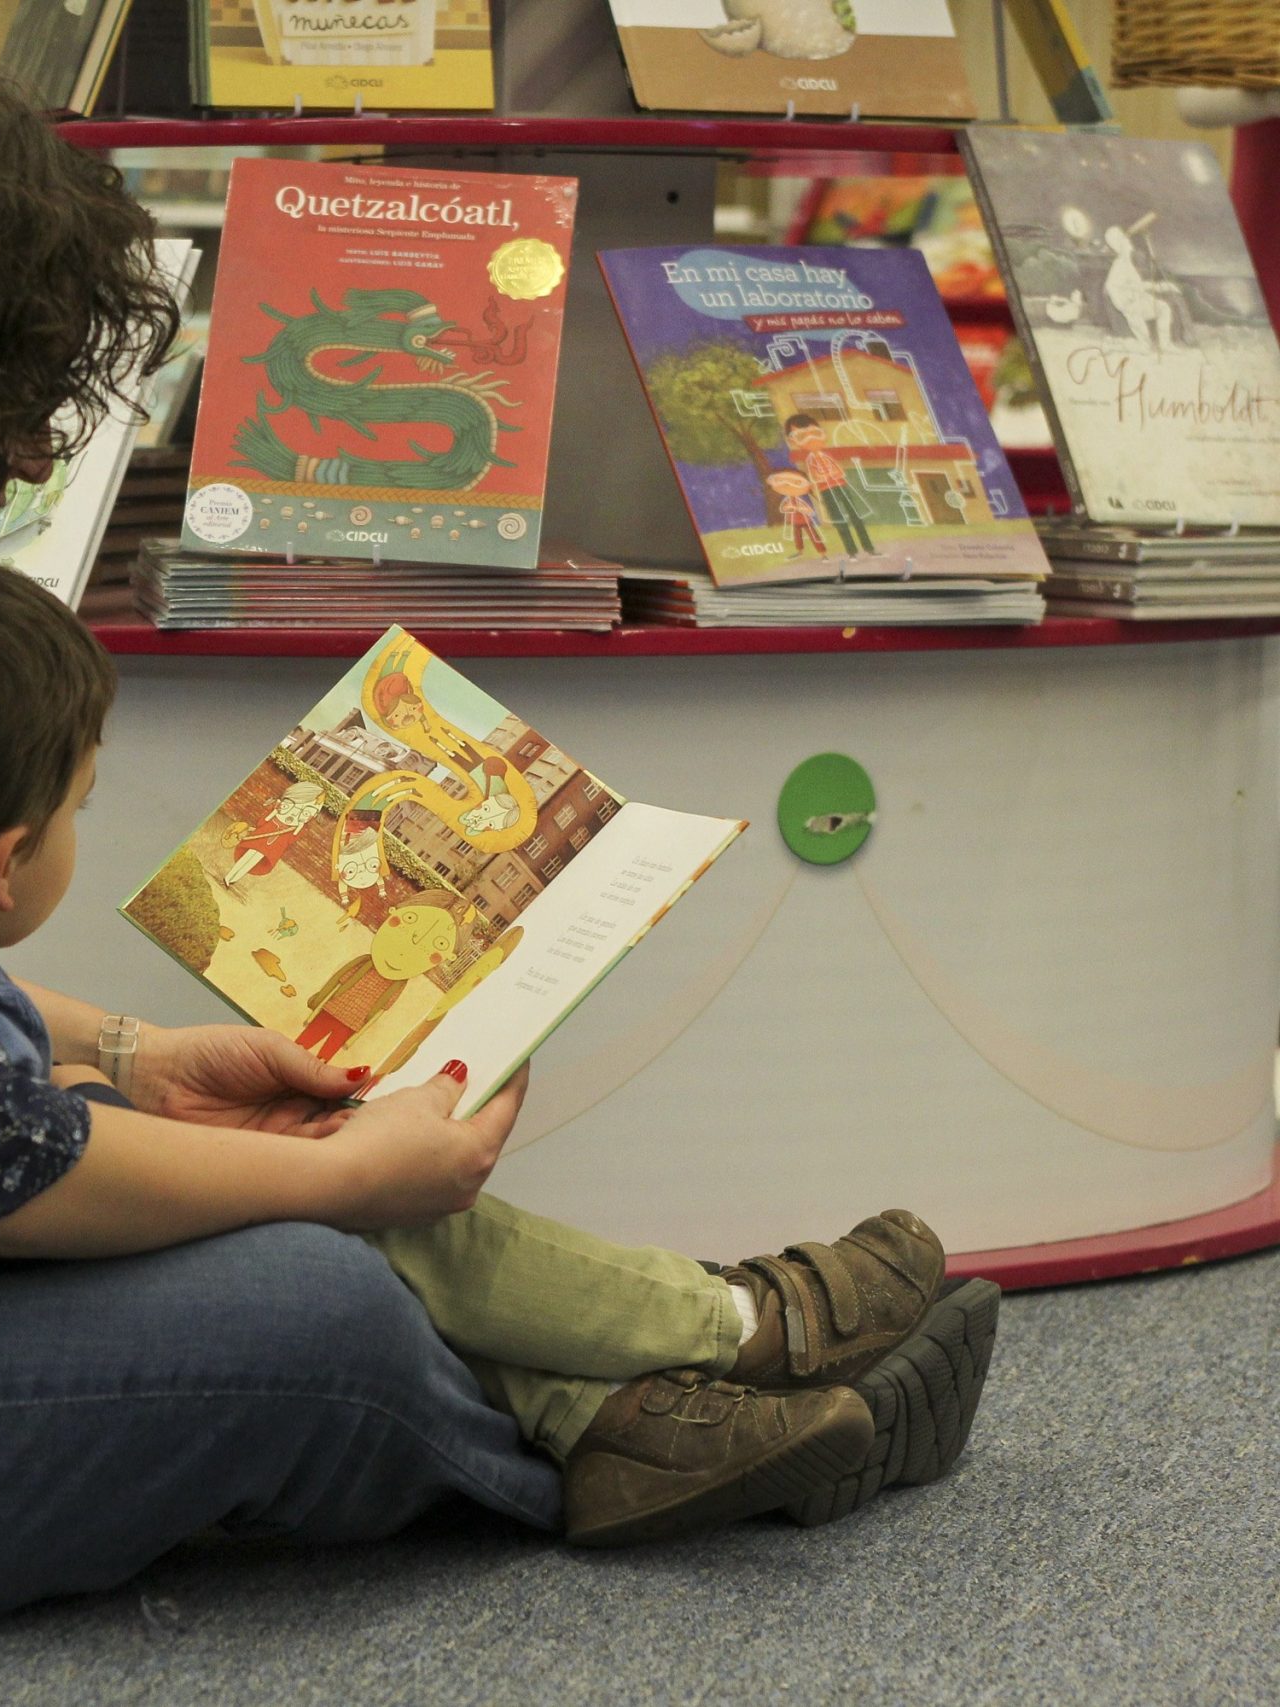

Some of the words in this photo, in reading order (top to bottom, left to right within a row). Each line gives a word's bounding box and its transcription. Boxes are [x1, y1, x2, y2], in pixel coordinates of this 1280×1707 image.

[290, 14, 410, 31] muñecas
[797, 77, 837, 91] CIDCLI
[450, 182, 461, 191] de
[275, 186, 520, 231] Quetzalcóatl,
[329, 226, 375, 236] misteriosa
[377, 228, 419, 239] Serpiente
[421, 230, 475, 241] Emplumada
[660, 262, 702, 284] En
[706, 261, 741, 283] mi
[745, 267, 800, 283] casa
[800, 260, 847, 289] hay
[700, 292, 737, 308] un
[736, 284, 875, 310] laboratorio
[754, 318, 765, 332] y
[767, 315, 786, 327] mis
[790, 313, 826, 330] papás
[827, 316, 846, 327] no
[846, 312, 863, 327] lo
[346, 531, 388, 543] CIDCLI
[741, 542, 784, 556] CIDCLI
